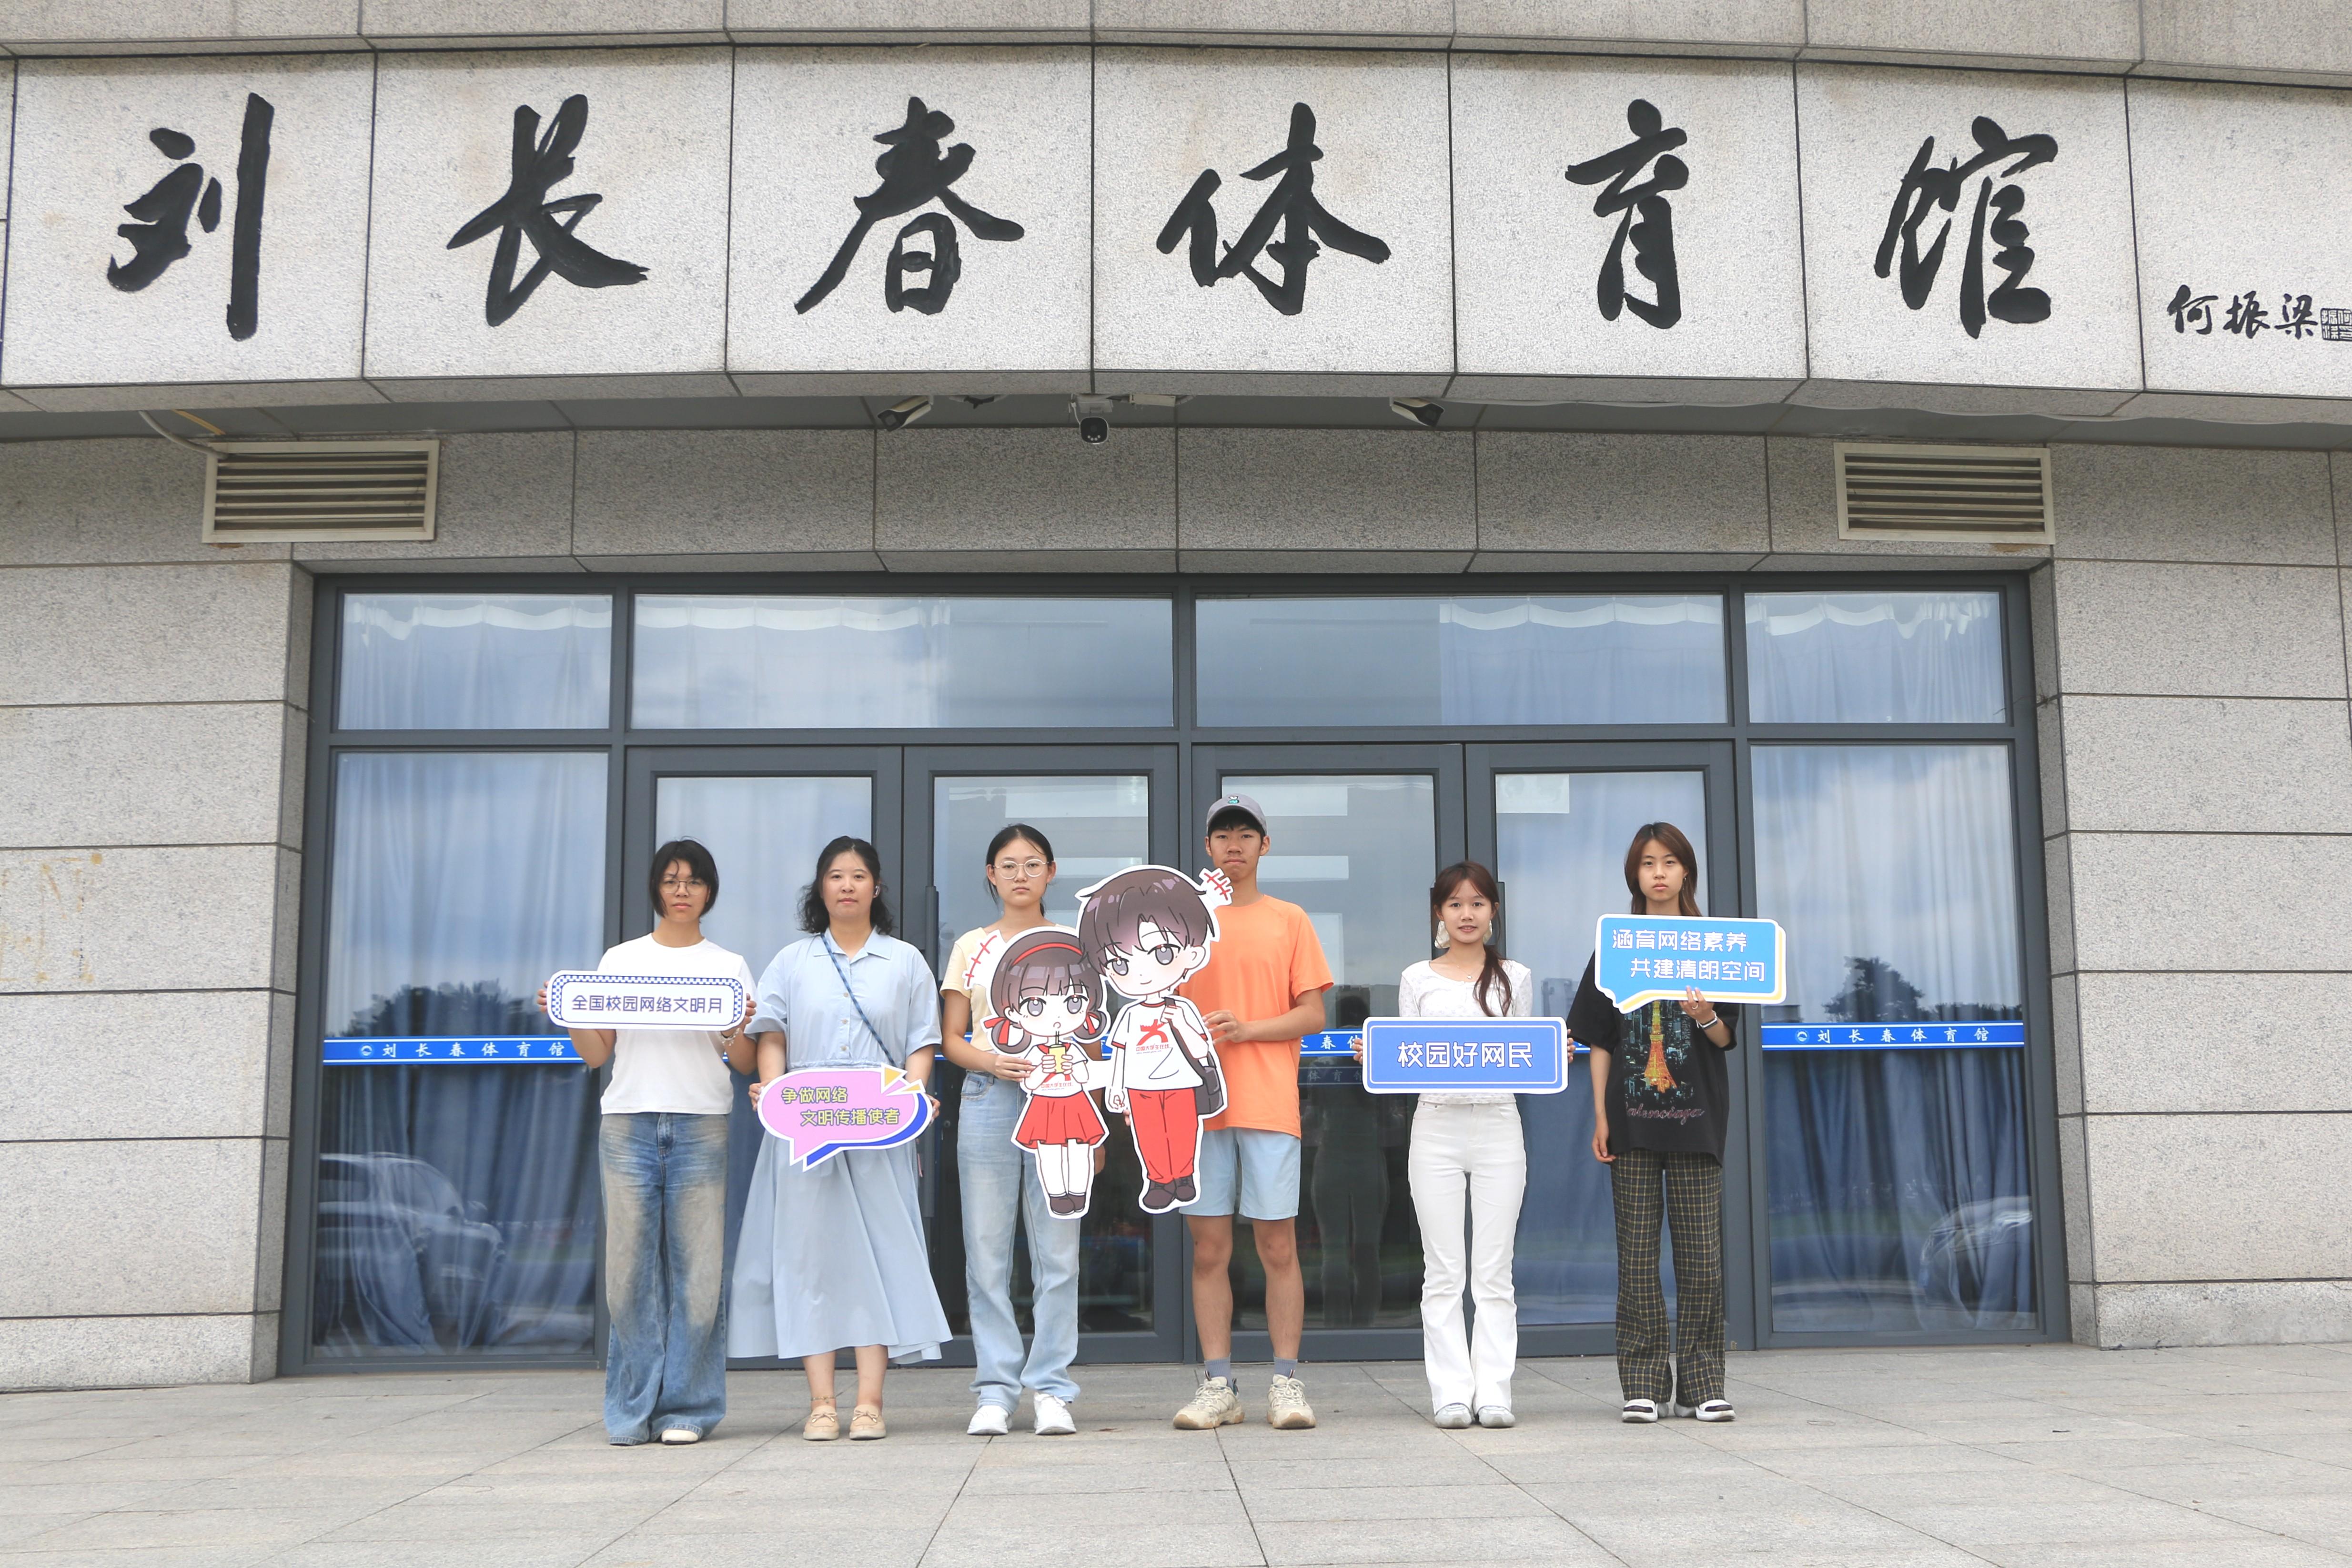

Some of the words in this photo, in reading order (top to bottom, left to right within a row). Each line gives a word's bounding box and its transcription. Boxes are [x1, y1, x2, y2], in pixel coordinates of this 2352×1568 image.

[108, 93, 2058, 339] 刘长春体育馆
[2167, 284, 2318, 339] 何振梁
[1612, 929, 1747, 952] 涵育网络素养
[1630, 957, 1765, 982] 共建清朗空间
[572, 995, 722, 1013] 全国校园网络文明月
[1817, 1027, 1989, 1043] 刘长春体育馆
[383, 1042, 565, 1058] 刘长春体育馆
[1397, 1042, 1533, 1068] 校园好网民
[781, 1087, 848, 1104] 争做网络
[800, 1108, 900, 1126] 文明传播使者
